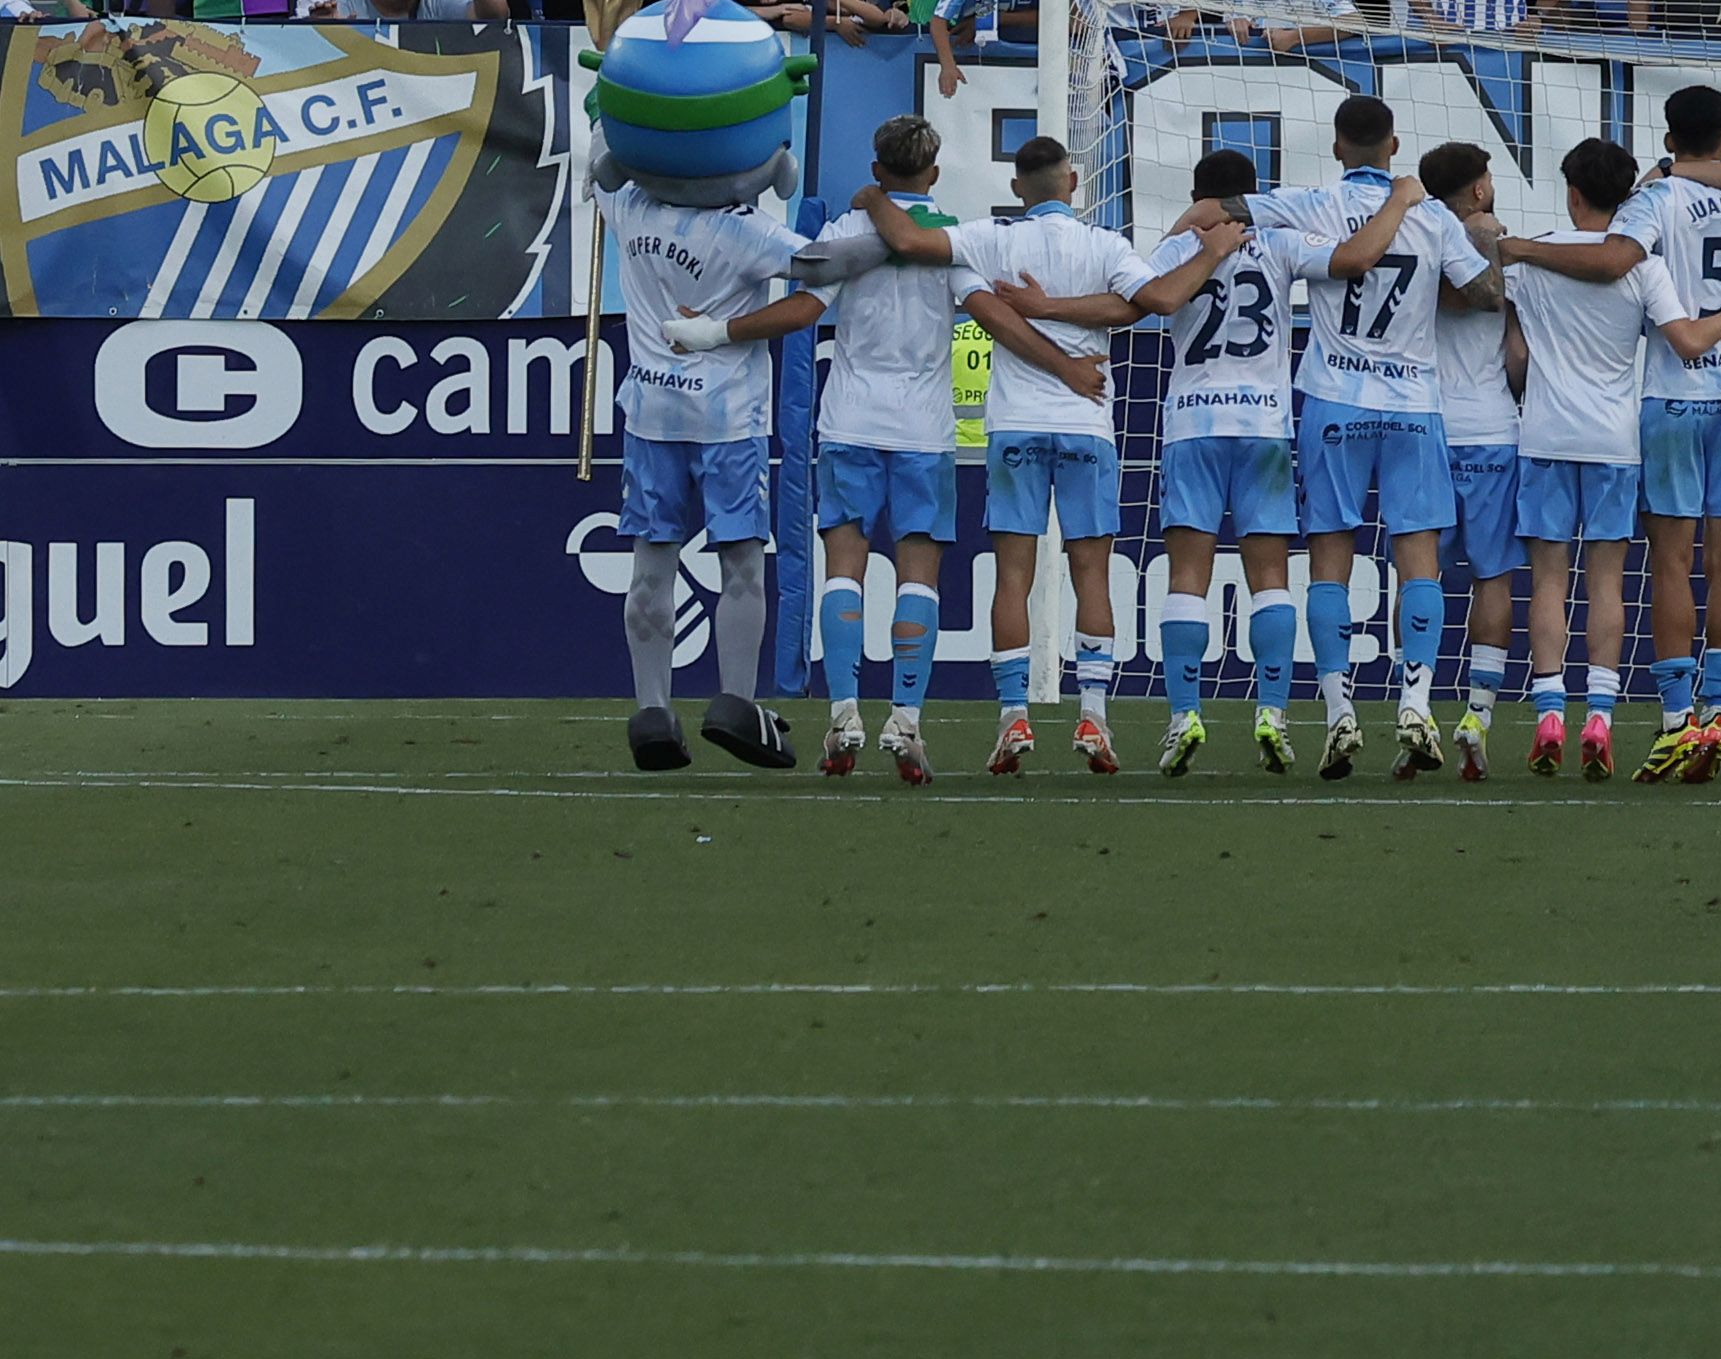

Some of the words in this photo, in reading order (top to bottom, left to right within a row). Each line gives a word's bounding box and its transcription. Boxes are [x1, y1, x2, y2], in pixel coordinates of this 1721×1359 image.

[39, 105, 290, 201] MALAGA
[299, 78, 403, 140] C.F.
[1184, 271, 1277, 367] 23
[1340, 254, 1420, 341] 17
[1176, 394, 1279, 411] BENAHAVIS
